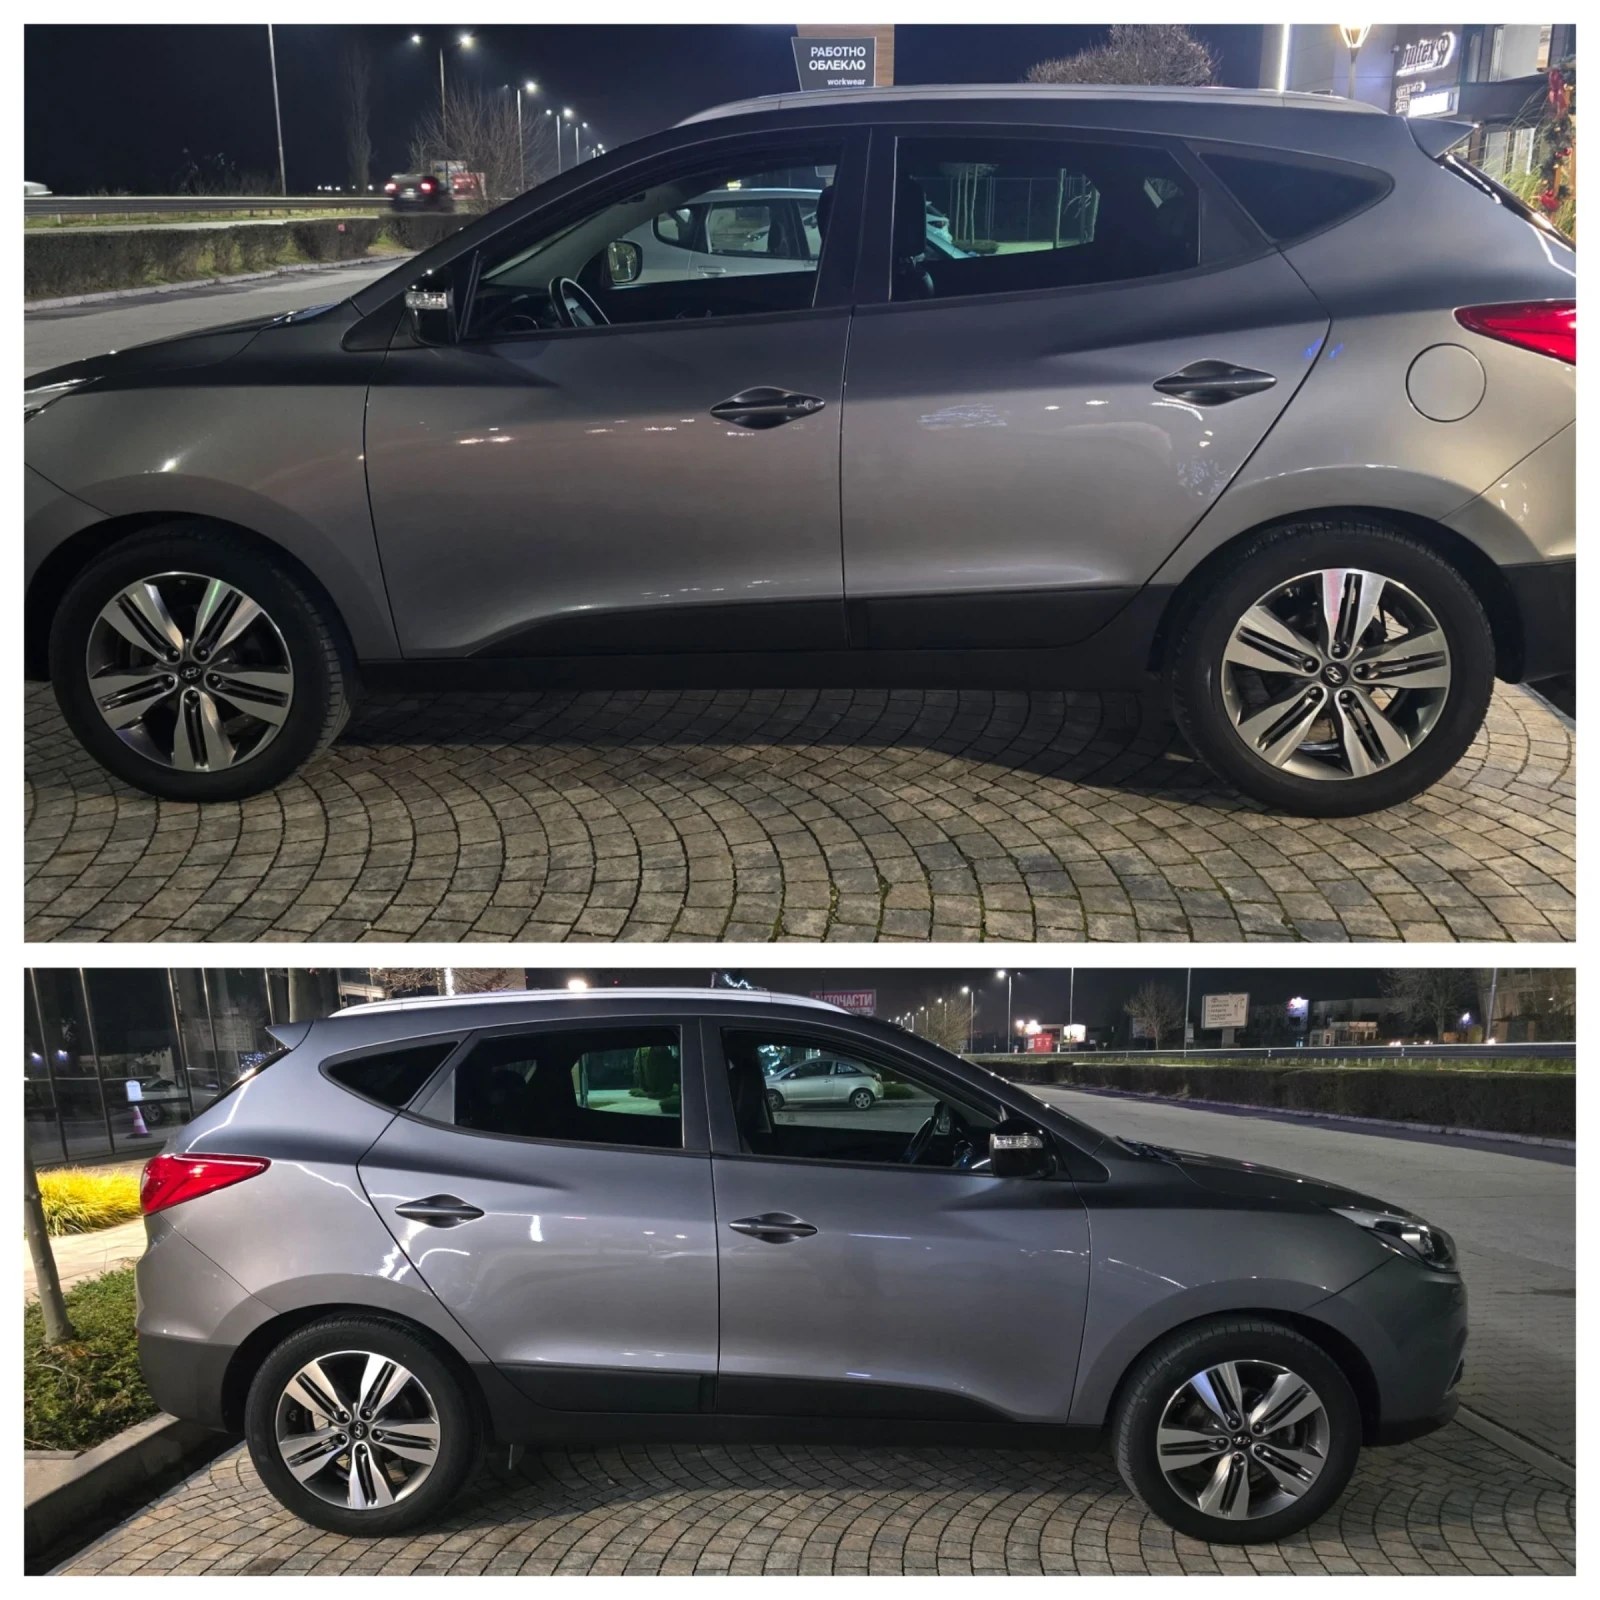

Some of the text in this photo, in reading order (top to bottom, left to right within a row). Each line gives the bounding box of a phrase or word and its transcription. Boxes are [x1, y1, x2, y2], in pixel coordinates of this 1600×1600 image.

[810, 46, 866, 57] РАБОТНО
[808, 60, 866, 71] ОБЛЕКЛО
[827, 78, 866, 86] workwear
